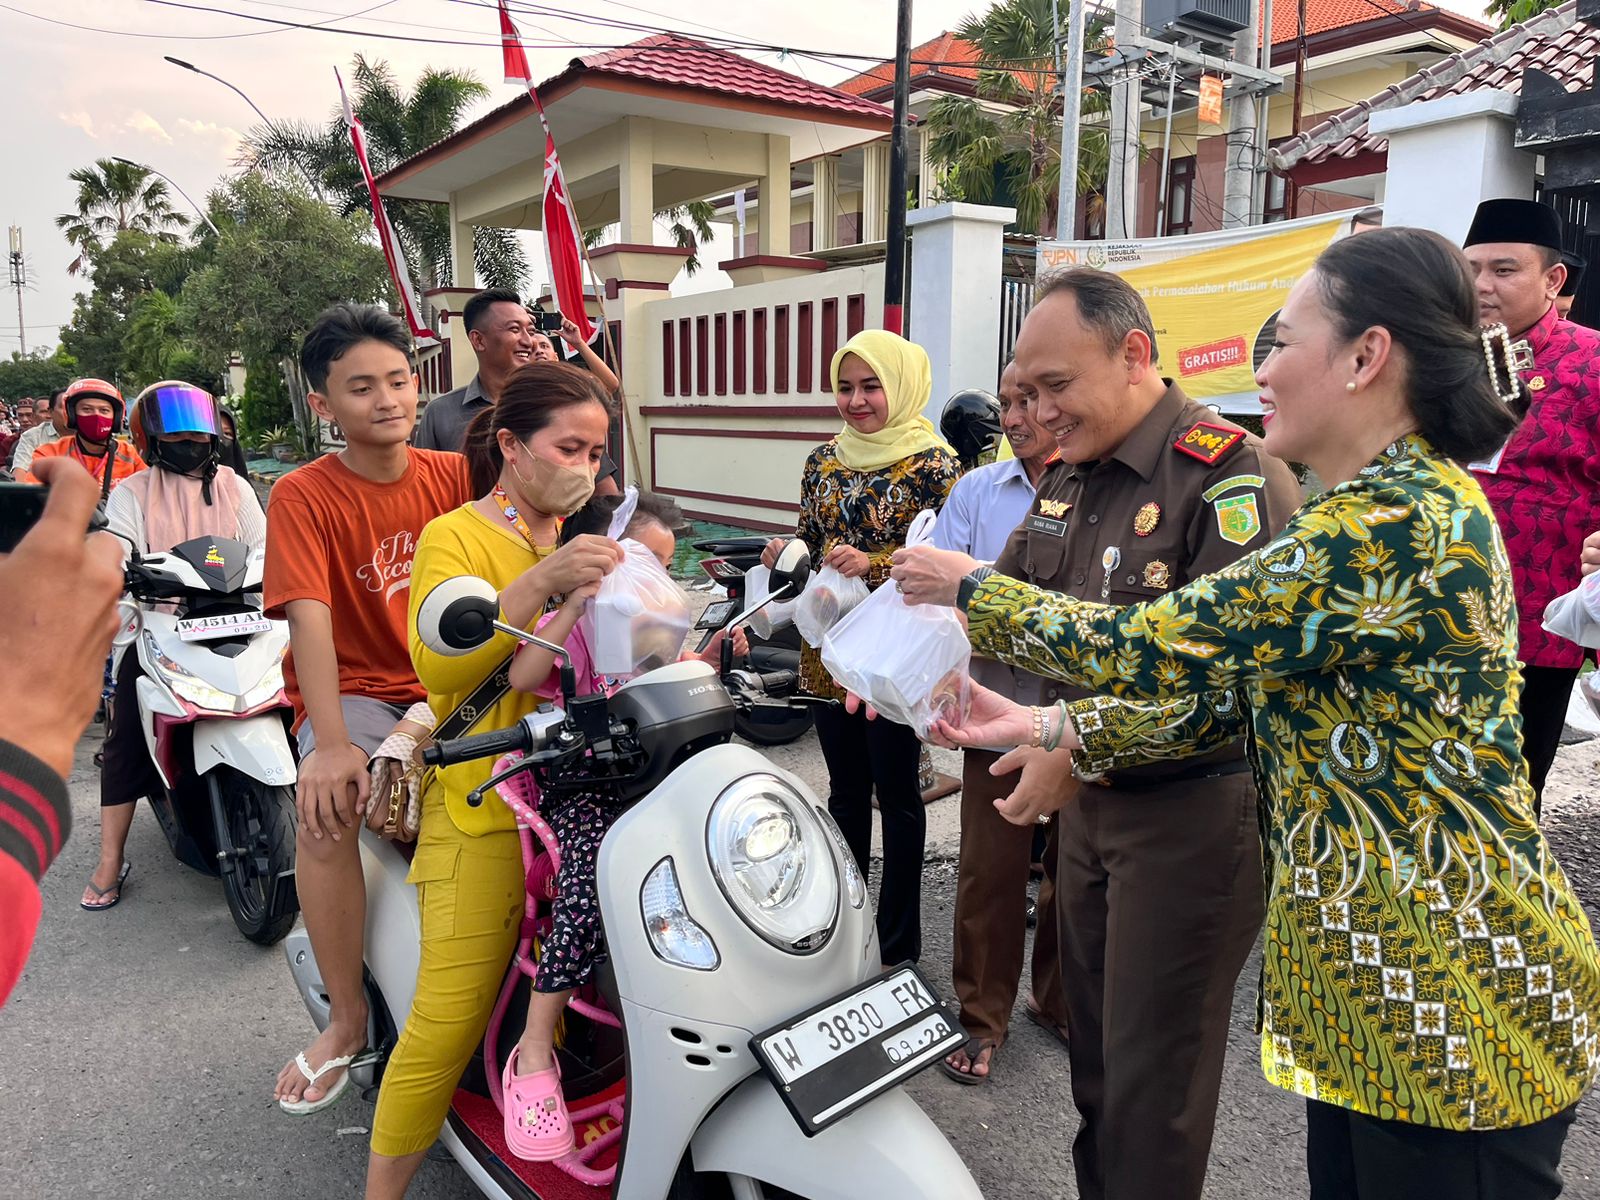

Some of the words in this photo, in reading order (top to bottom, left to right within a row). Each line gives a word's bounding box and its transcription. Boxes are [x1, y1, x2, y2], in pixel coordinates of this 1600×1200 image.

[1108, 254, 1141, 263] INDONESIA
[1153, 283, 1224, 297] Permasalahan
[1228, 279, 1267, 292] Hukum
[1184, 346, 1239, 369] GRATIS!!!
[380, 530, 420, 564] Th
[180, 620, 194, 630] W
[199, 615, 239, 627] 4514
[773, 1036, 803, 1072] W
[817, 1002, 884, 1051] 3830
[890, 978, 936, 1017] FK
